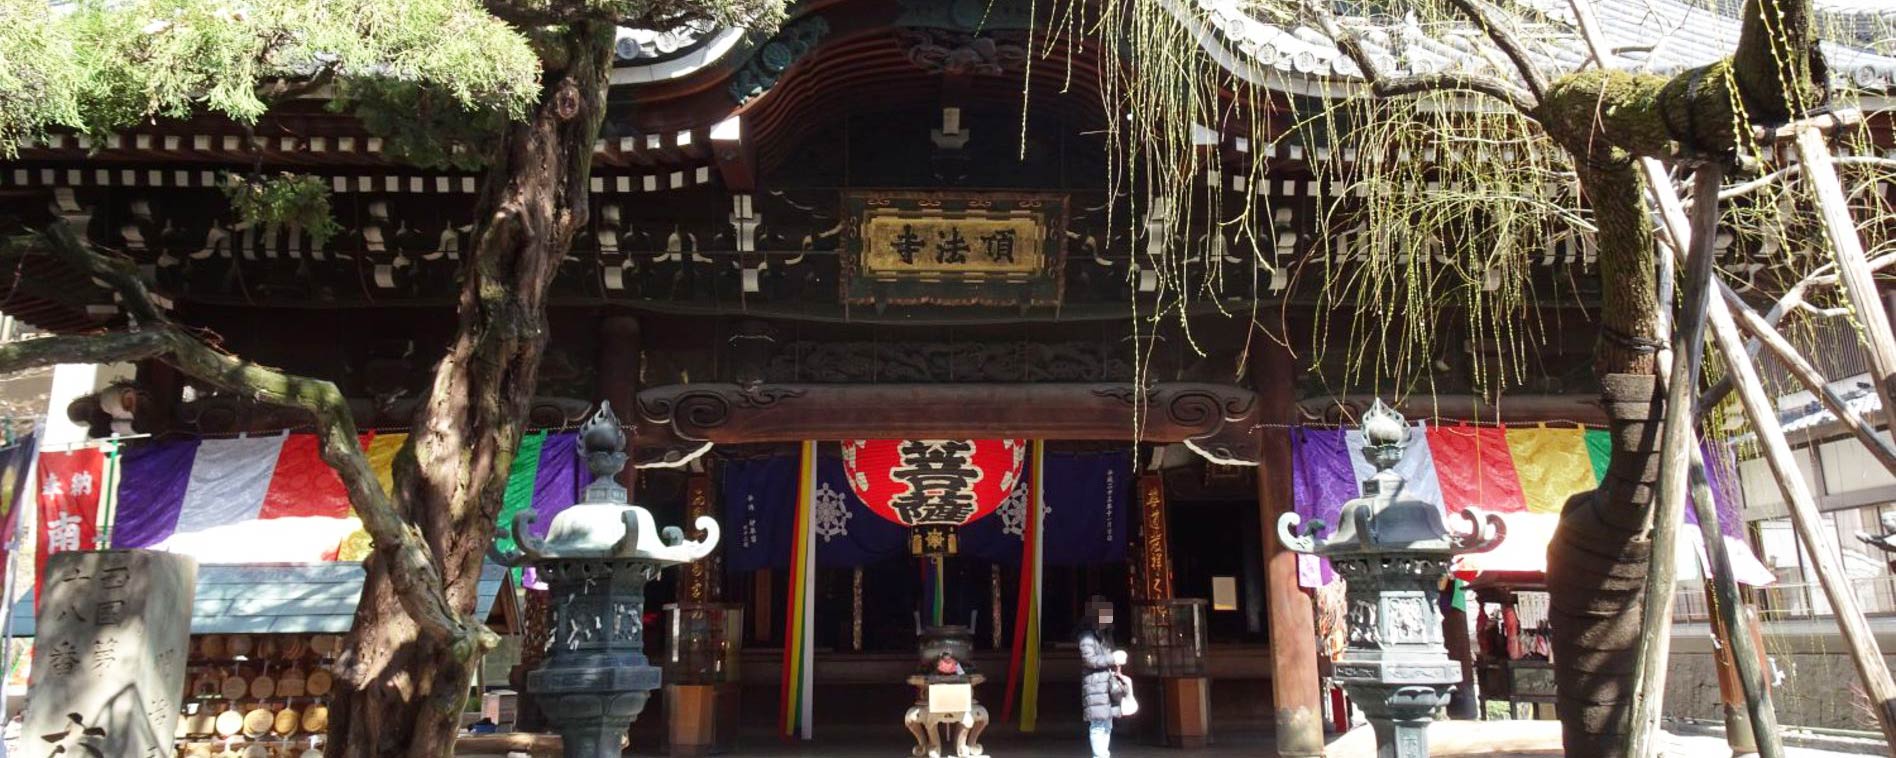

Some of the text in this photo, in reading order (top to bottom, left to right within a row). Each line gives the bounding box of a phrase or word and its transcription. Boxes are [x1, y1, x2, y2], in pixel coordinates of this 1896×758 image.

[890, 223, 1016, 264] 頂法寺
[42, 470, 92, 500] 奉納
